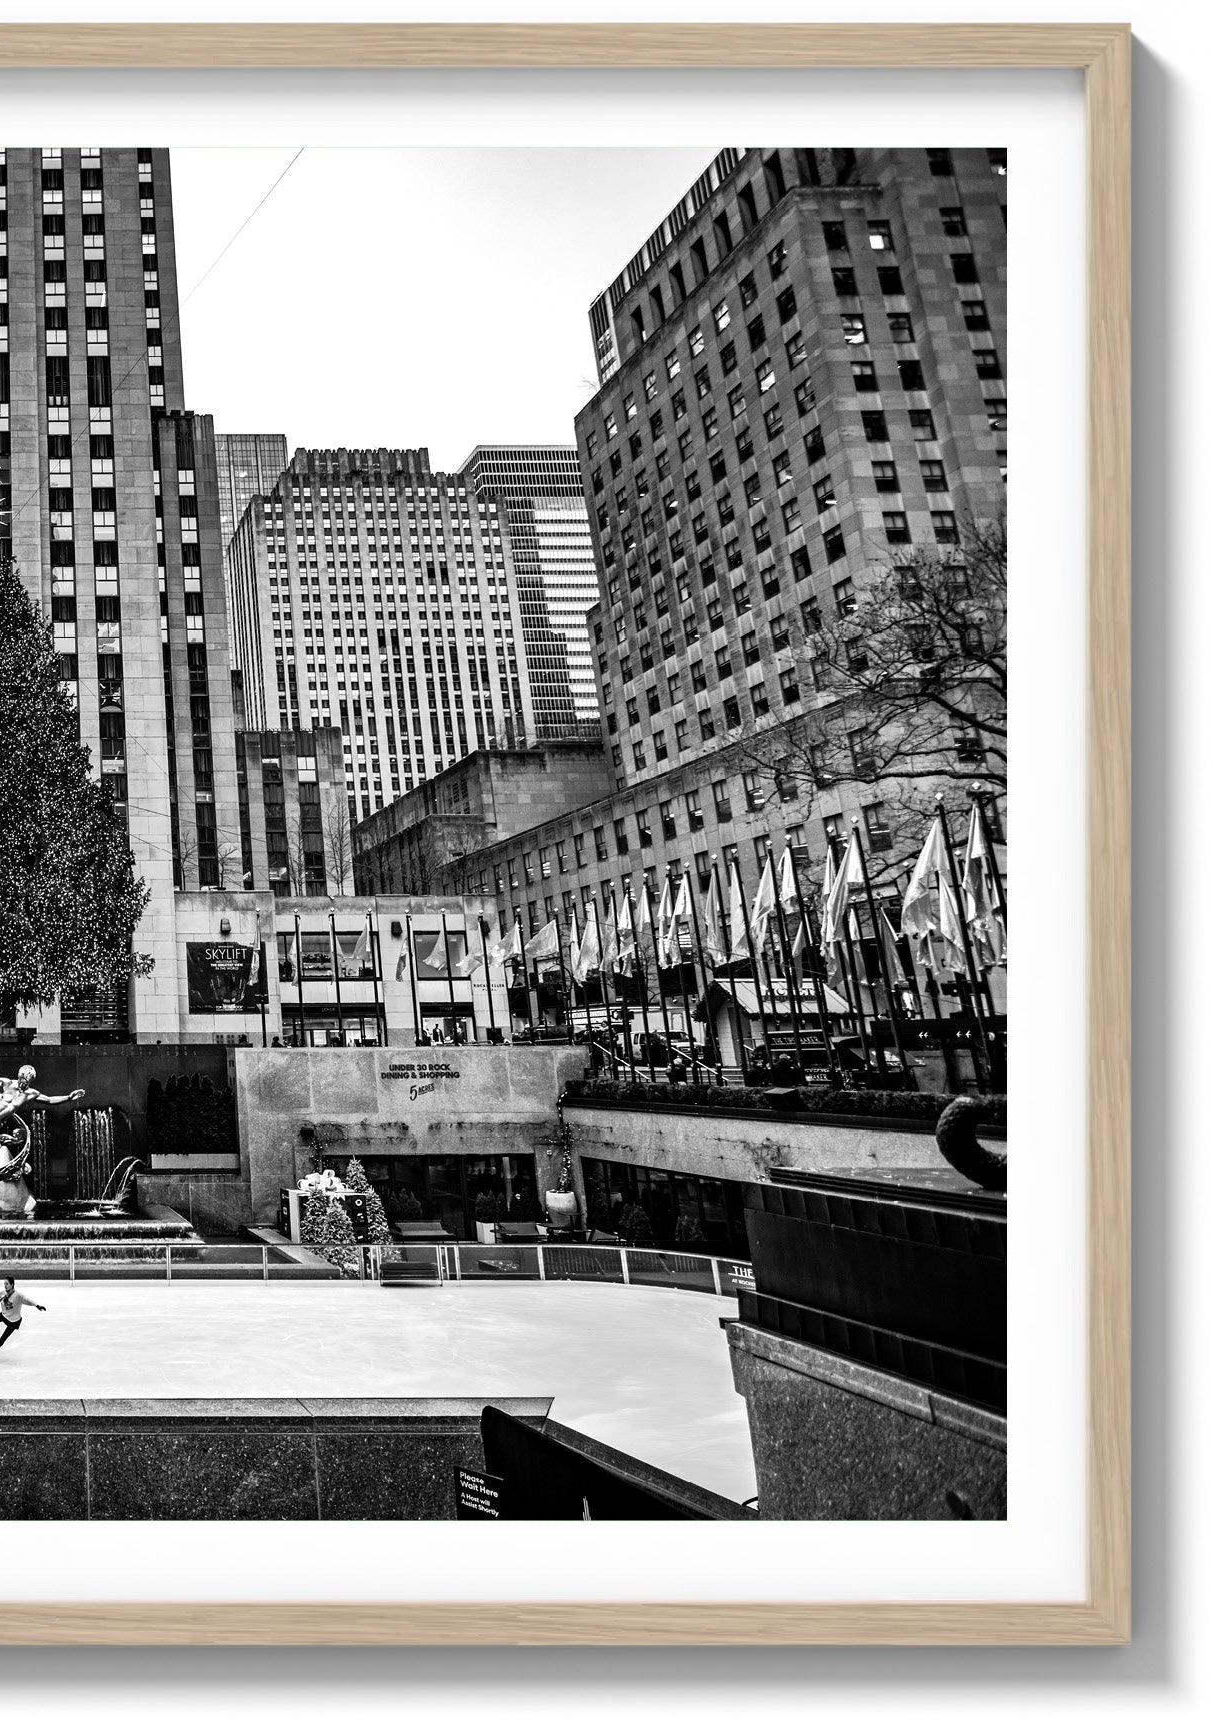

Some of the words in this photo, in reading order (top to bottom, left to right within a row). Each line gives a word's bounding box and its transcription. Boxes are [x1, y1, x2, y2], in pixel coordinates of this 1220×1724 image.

[205, 948, 247, 960] SKYLIFT
[388, 1064, 416, 1072] UNDER
[410, 1071, 417, 1079] &
[418, 1071, 460, 1079] SHOPPING
[409, 1084, 418, 1101] 5
[418, 1083, 435, 1095] ACRES
[732, 1265, 753, 1279] THE
[460, 1471, 484, 1485] Please
[460, 1480, 479, 1492] Wait
[479, 1485, 499, 1498] Here
[466, 1493, 479, 1503] Host
[461, 1499, 478, 1509] Assist
[478, 1504, 499, 1518] Shortly
